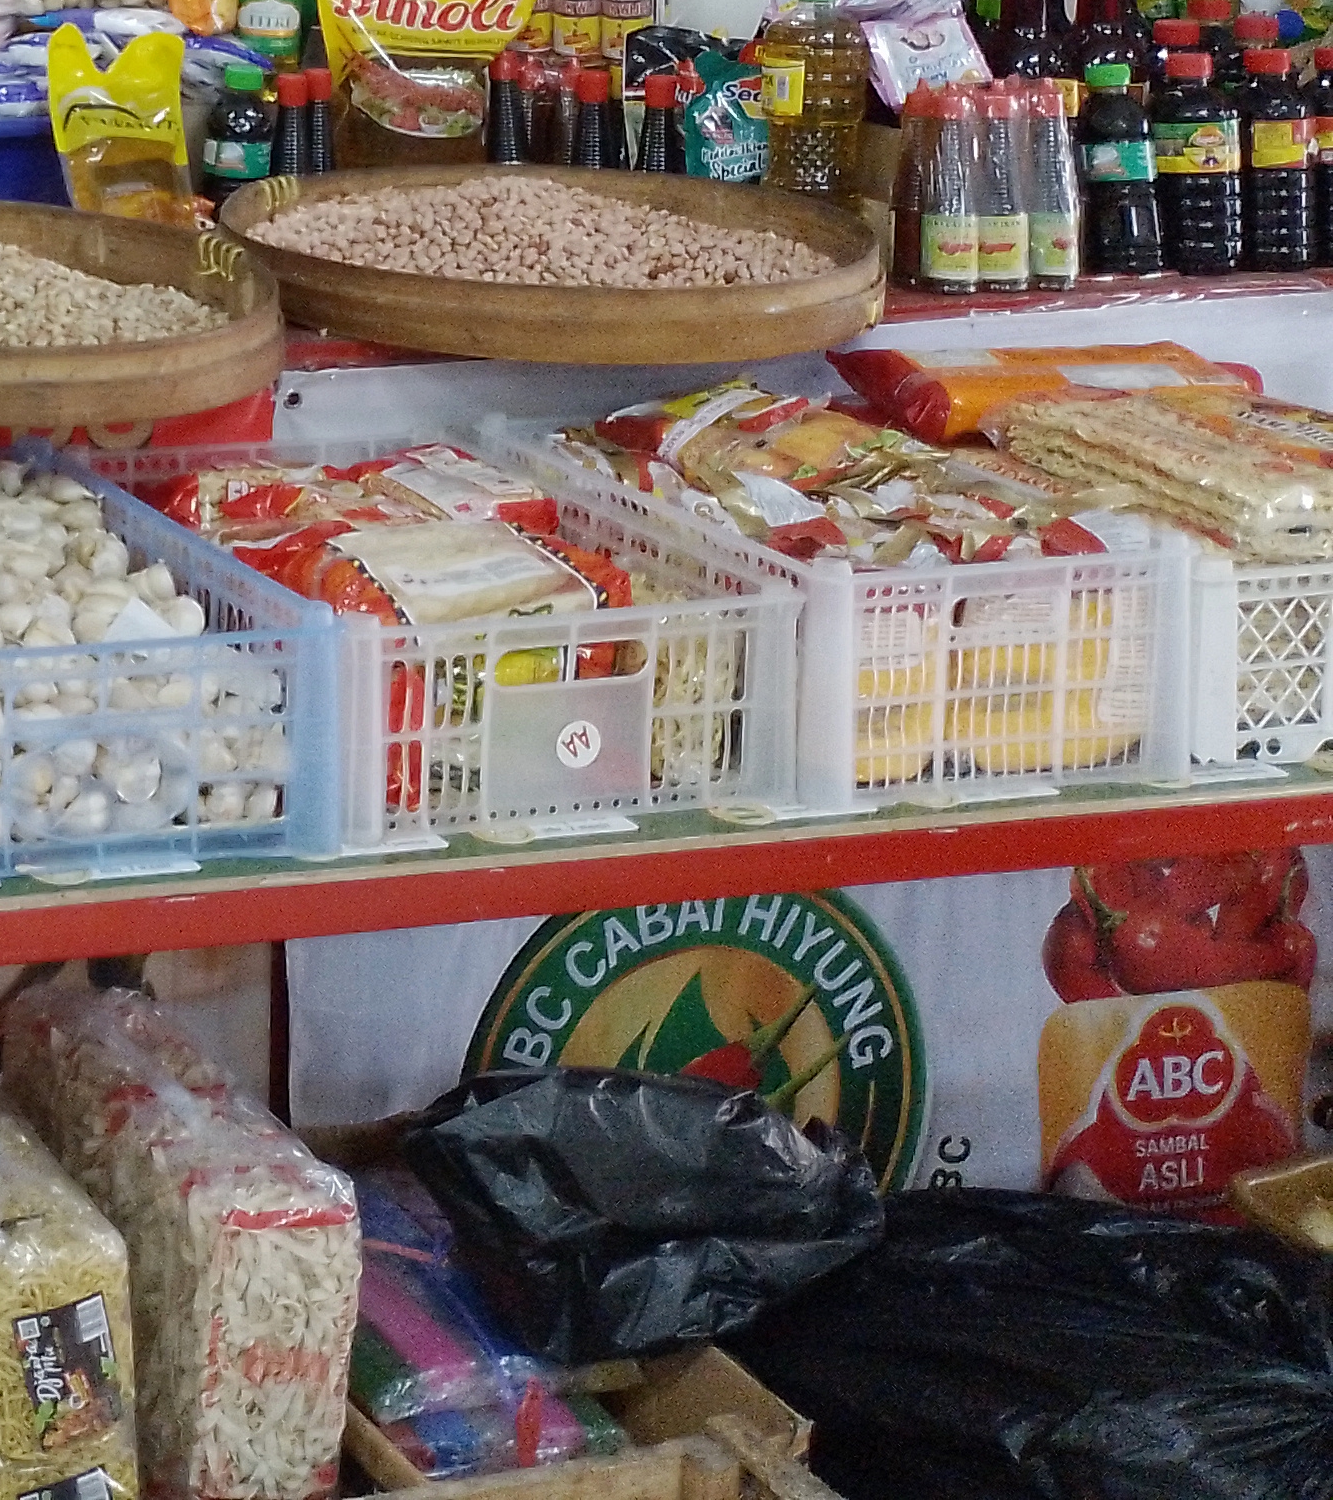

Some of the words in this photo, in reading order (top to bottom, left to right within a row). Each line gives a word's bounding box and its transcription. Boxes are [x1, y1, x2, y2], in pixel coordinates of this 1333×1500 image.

[710, 155, 765, 183] Special
[565, 896, 725, 988] CABAI
[737, 894, 894, 1069] HIYUNG
[1127, 1050, 1224, 1102] ABC
[1135, 1132, 1210, 1158] SAMBAL
[1139, 1157, 1205, 1192] ASLI
